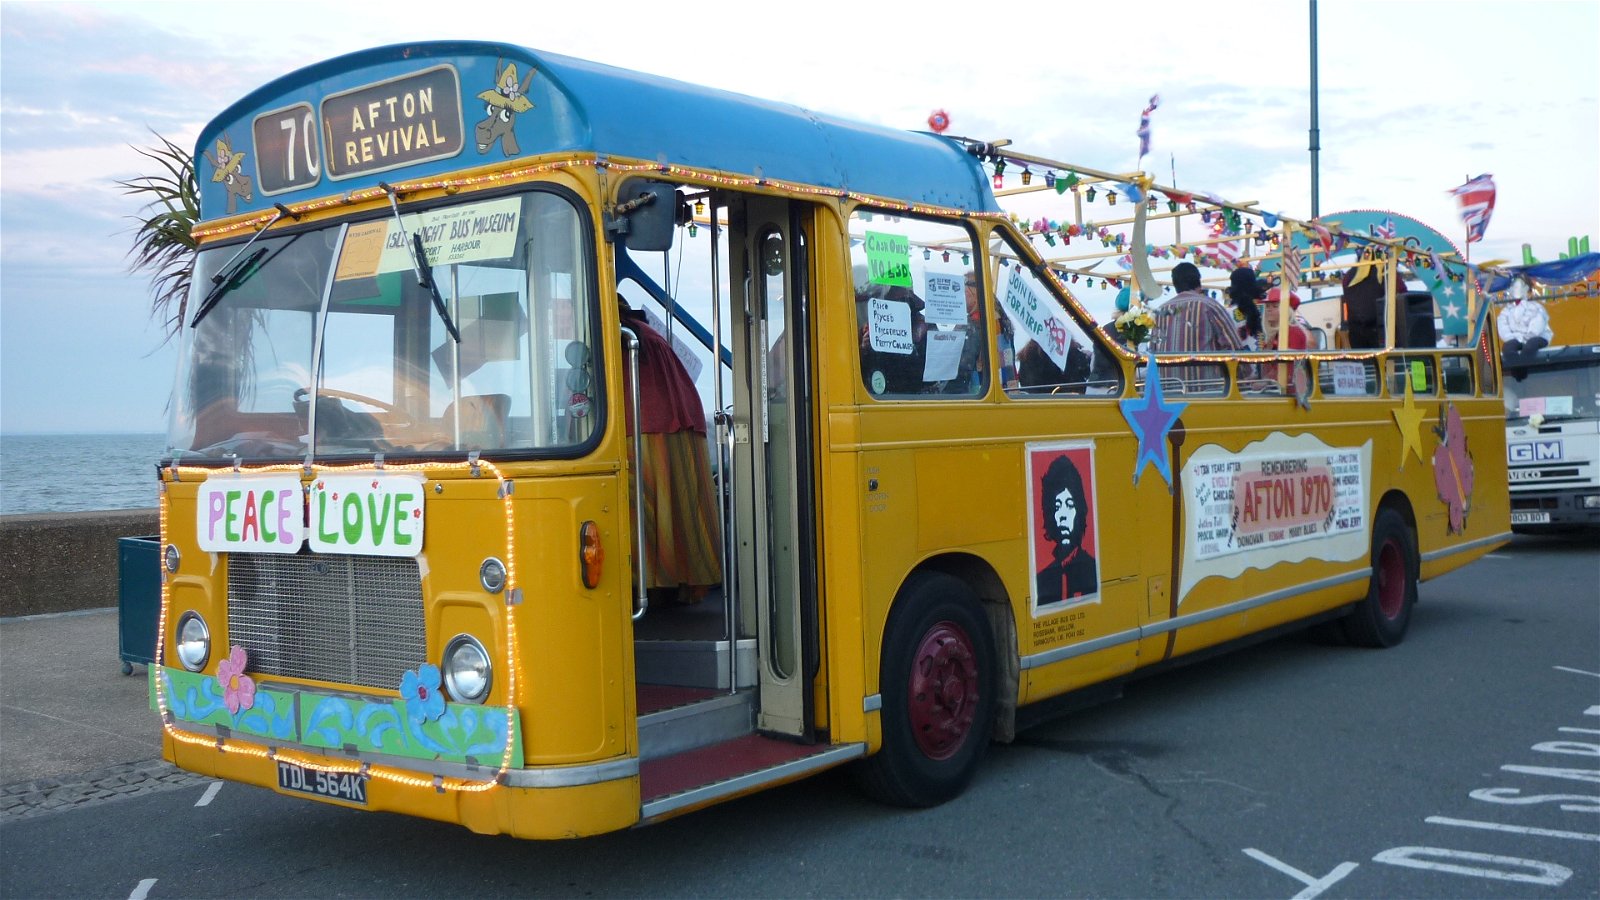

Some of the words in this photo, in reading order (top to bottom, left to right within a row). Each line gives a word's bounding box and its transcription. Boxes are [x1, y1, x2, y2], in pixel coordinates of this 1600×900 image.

[351, 87, 434, 132] AFTON
[280, 111, 318, 182] 70
[345, 123, 447, 166] REVIVAL
[449, 219, 472, 241] BUS
[471, 211, 516, 236] MUSEUM
[450, 239, 481, 254] HARBOUR
[870, 258, 885, 279] NO
[1009, 273, 1028, 298] JOIN
[1027, 291, 1038, 311] US
[1006, 289, 1021, 316] FOR
[1019, 307, 1025, 319] A
[1025, 310, 1044, 336] TRIP
[1261, 457, 1308, 476] REMEMBERING
[1212, 489, 1235, 502] CHICAGO
[1243, 478, 1295, 523] AFTON
[1301, 474, 1331, 515] 1970
[208, 488, 294, 545] PEACE
[317, 489, 415, 547] LOVE
[1236, 532, 1264, 548] DONOVAN
[1042, 617, 1059, 628] VILLAGE
[278, 765, 314, 793] TDL
[315, 769, 365, 801] 564K
